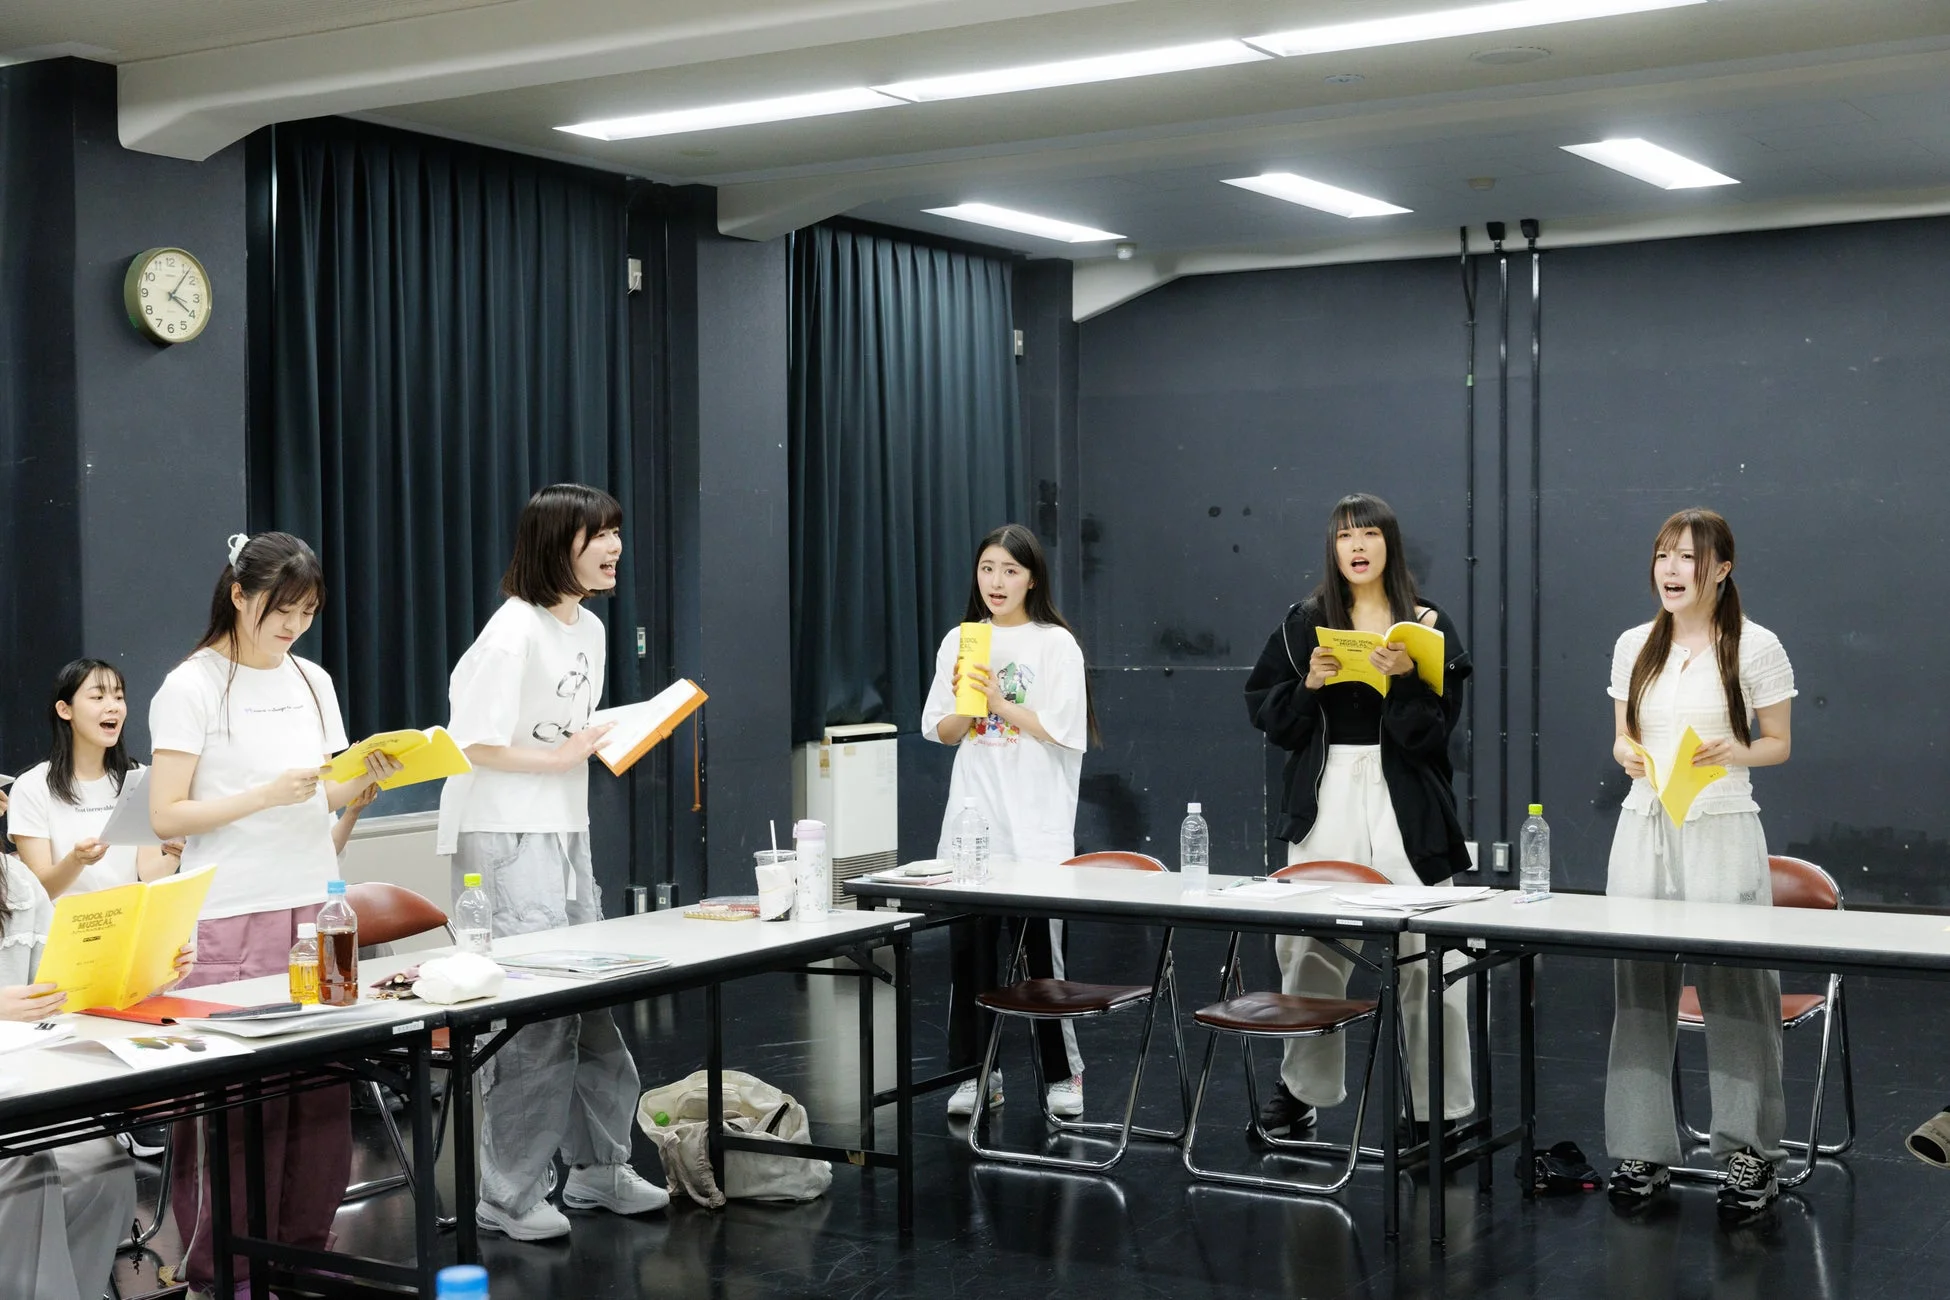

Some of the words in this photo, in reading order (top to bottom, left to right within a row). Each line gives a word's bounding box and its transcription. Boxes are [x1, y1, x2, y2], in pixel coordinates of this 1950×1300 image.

[154, 260, 162, 271] 11
[166, 257, 176, 268] 12
[144, 271, 156, 282] 10
[188, 275, 196, 286] 2
[141, 287, 149, 298] 9
[192, 293, 201, 304] 3
[145, 304, 153, 315] 8
[188, 309, 196, 319] 4
[155, 318, 163, 328] 7
[167, 323, 175, 334] 6
[179, 320, 188, 331] 5
[72, 911, 103, 923] SCHOOL
[105, 907, 123, 918] IDOL
[78, 917, 112, 930] MUSICAL
